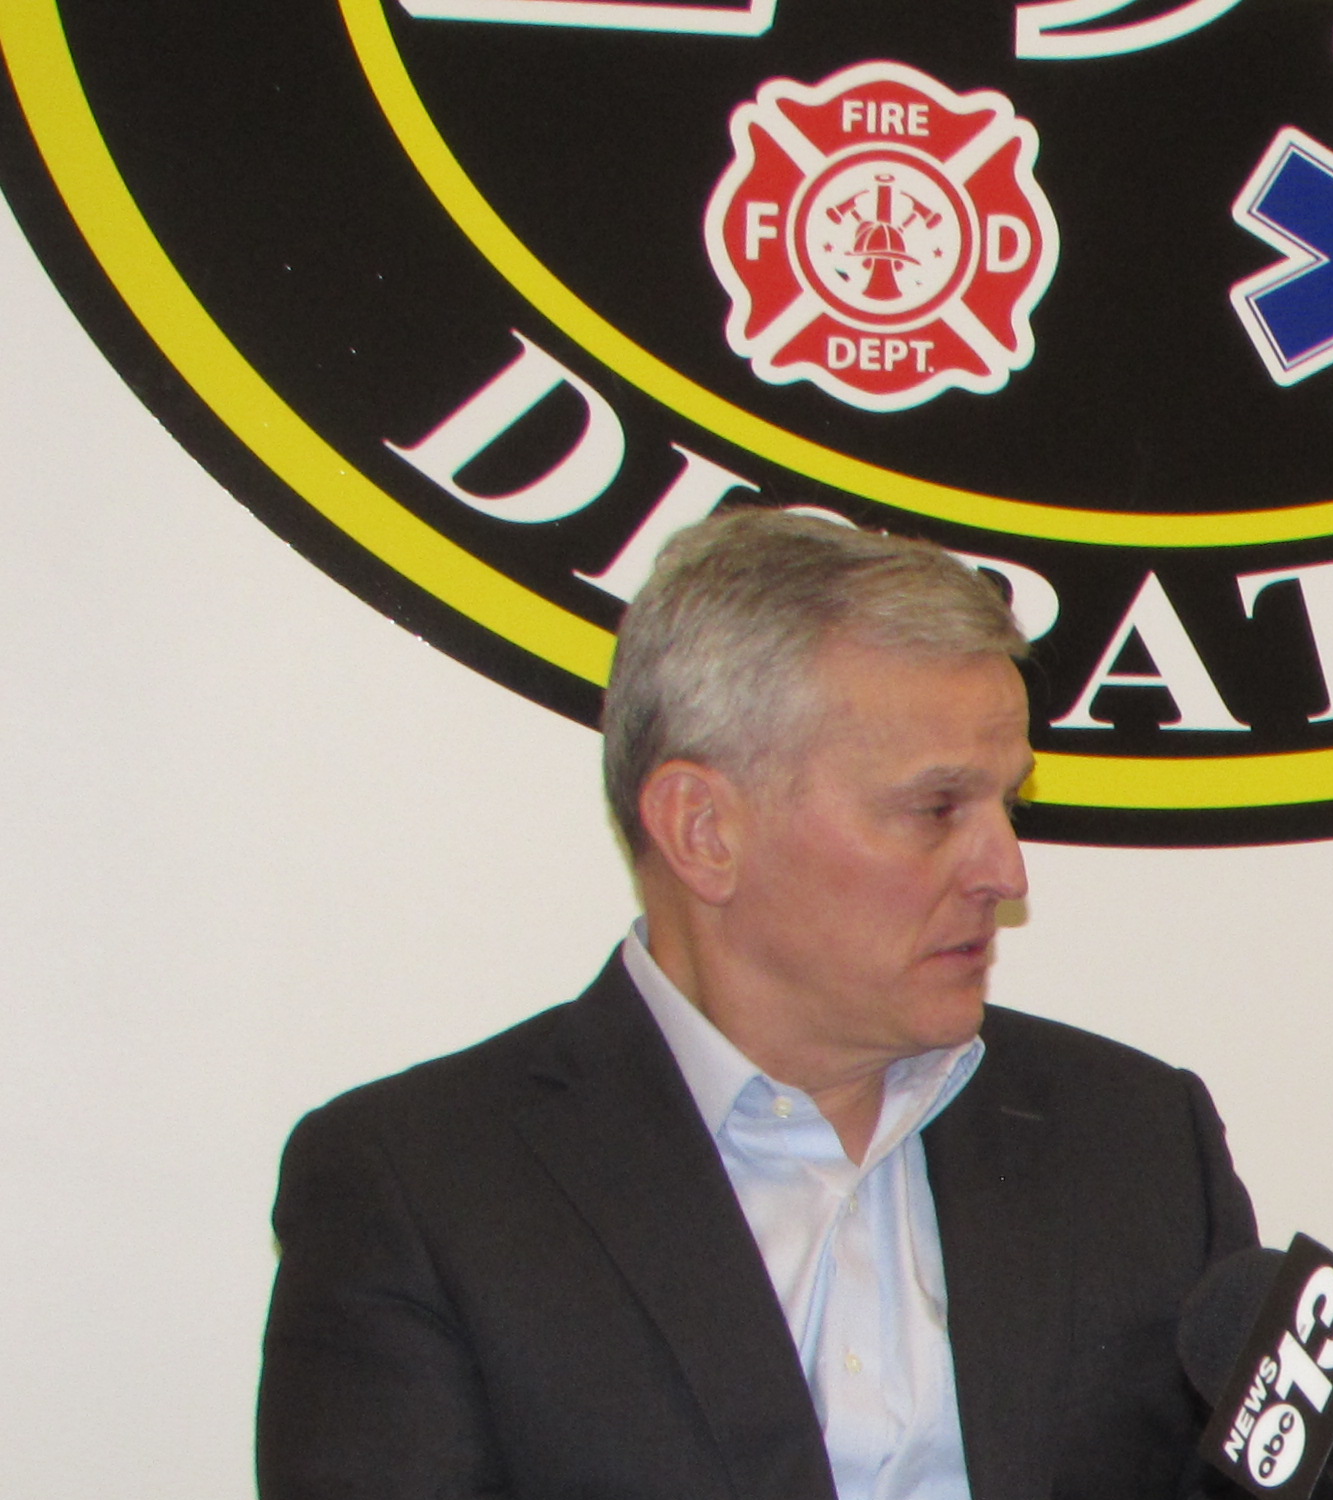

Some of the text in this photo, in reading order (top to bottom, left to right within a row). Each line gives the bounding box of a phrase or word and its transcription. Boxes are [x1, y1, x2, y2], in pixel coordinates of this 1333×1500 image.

[842, 99, 930, 136] FIRE
[745, 202, 1032, 274] F D
[827, 336, 935, 373] DEPT.
[1222, 1355, 1278, 1463] NEWS
[1258, 1411, 1295, 1479] abc
